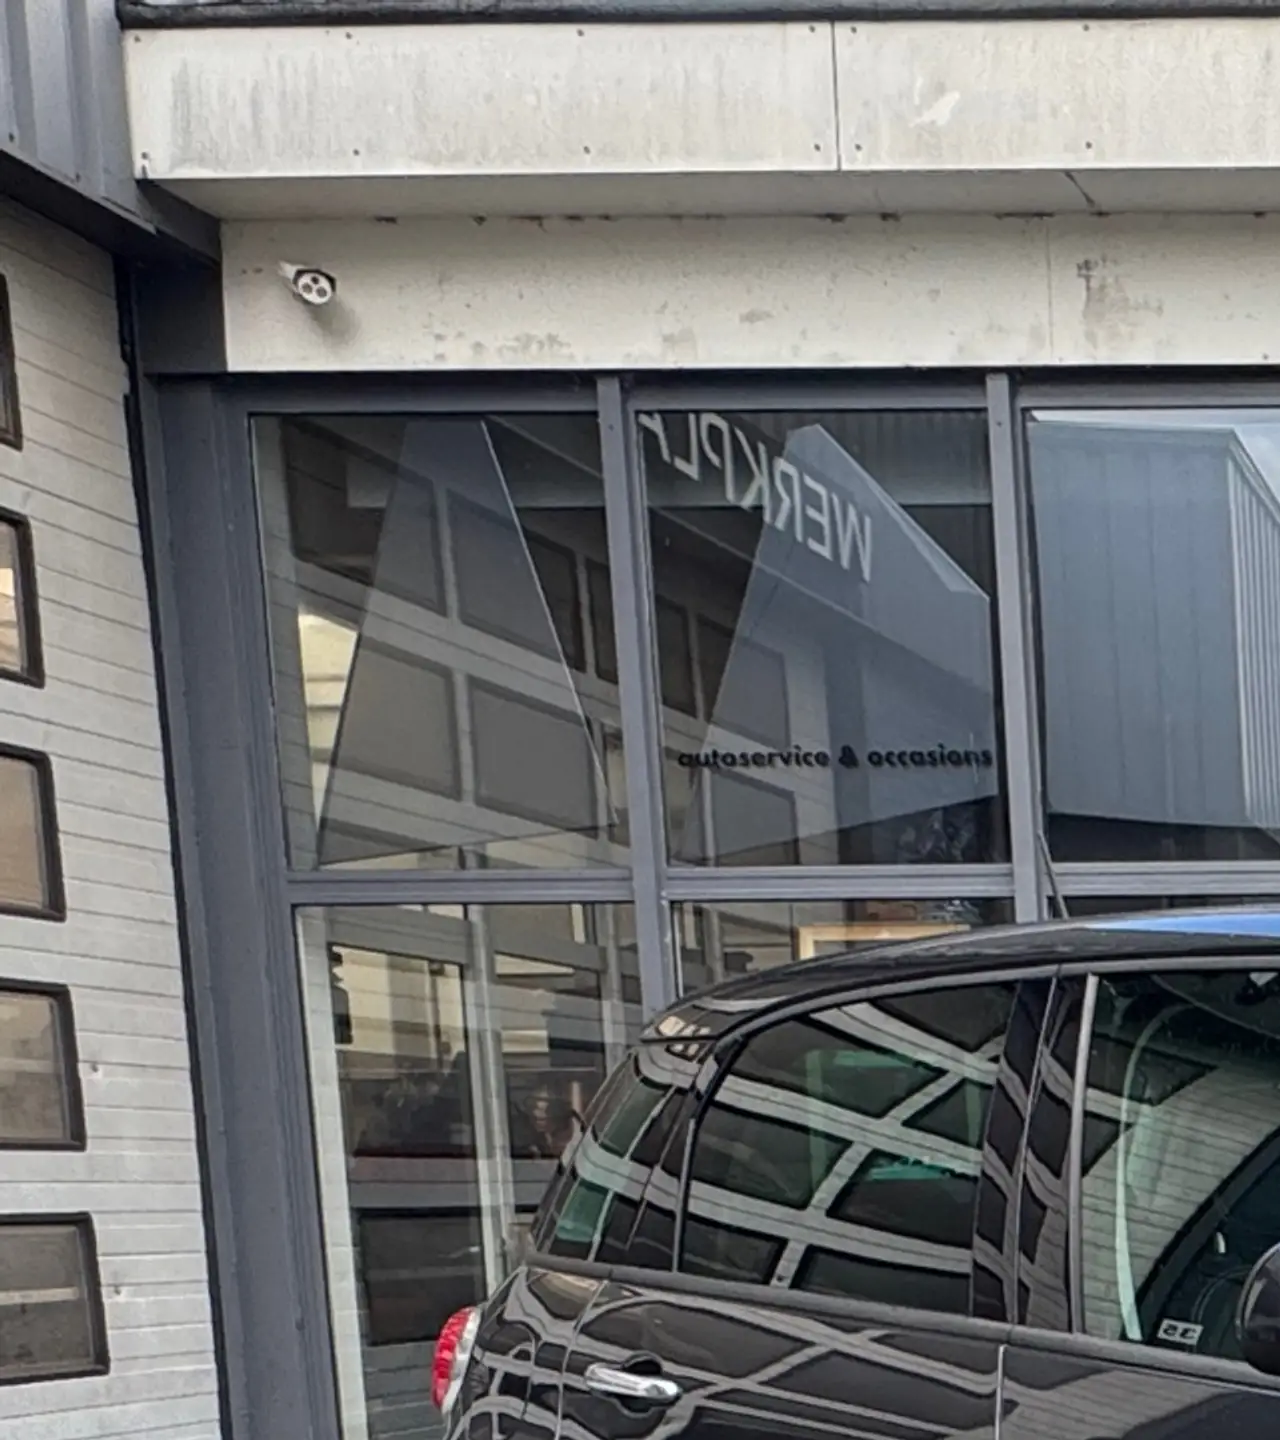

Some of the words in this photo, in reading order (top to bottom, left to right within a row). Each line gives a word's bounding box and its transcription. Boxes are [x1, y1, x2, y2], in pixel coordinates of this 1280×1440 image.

[678, 745, 831, 769] autoservice
[838, 745, 861, 769] &
[867, 743, 993, 768] occasions
